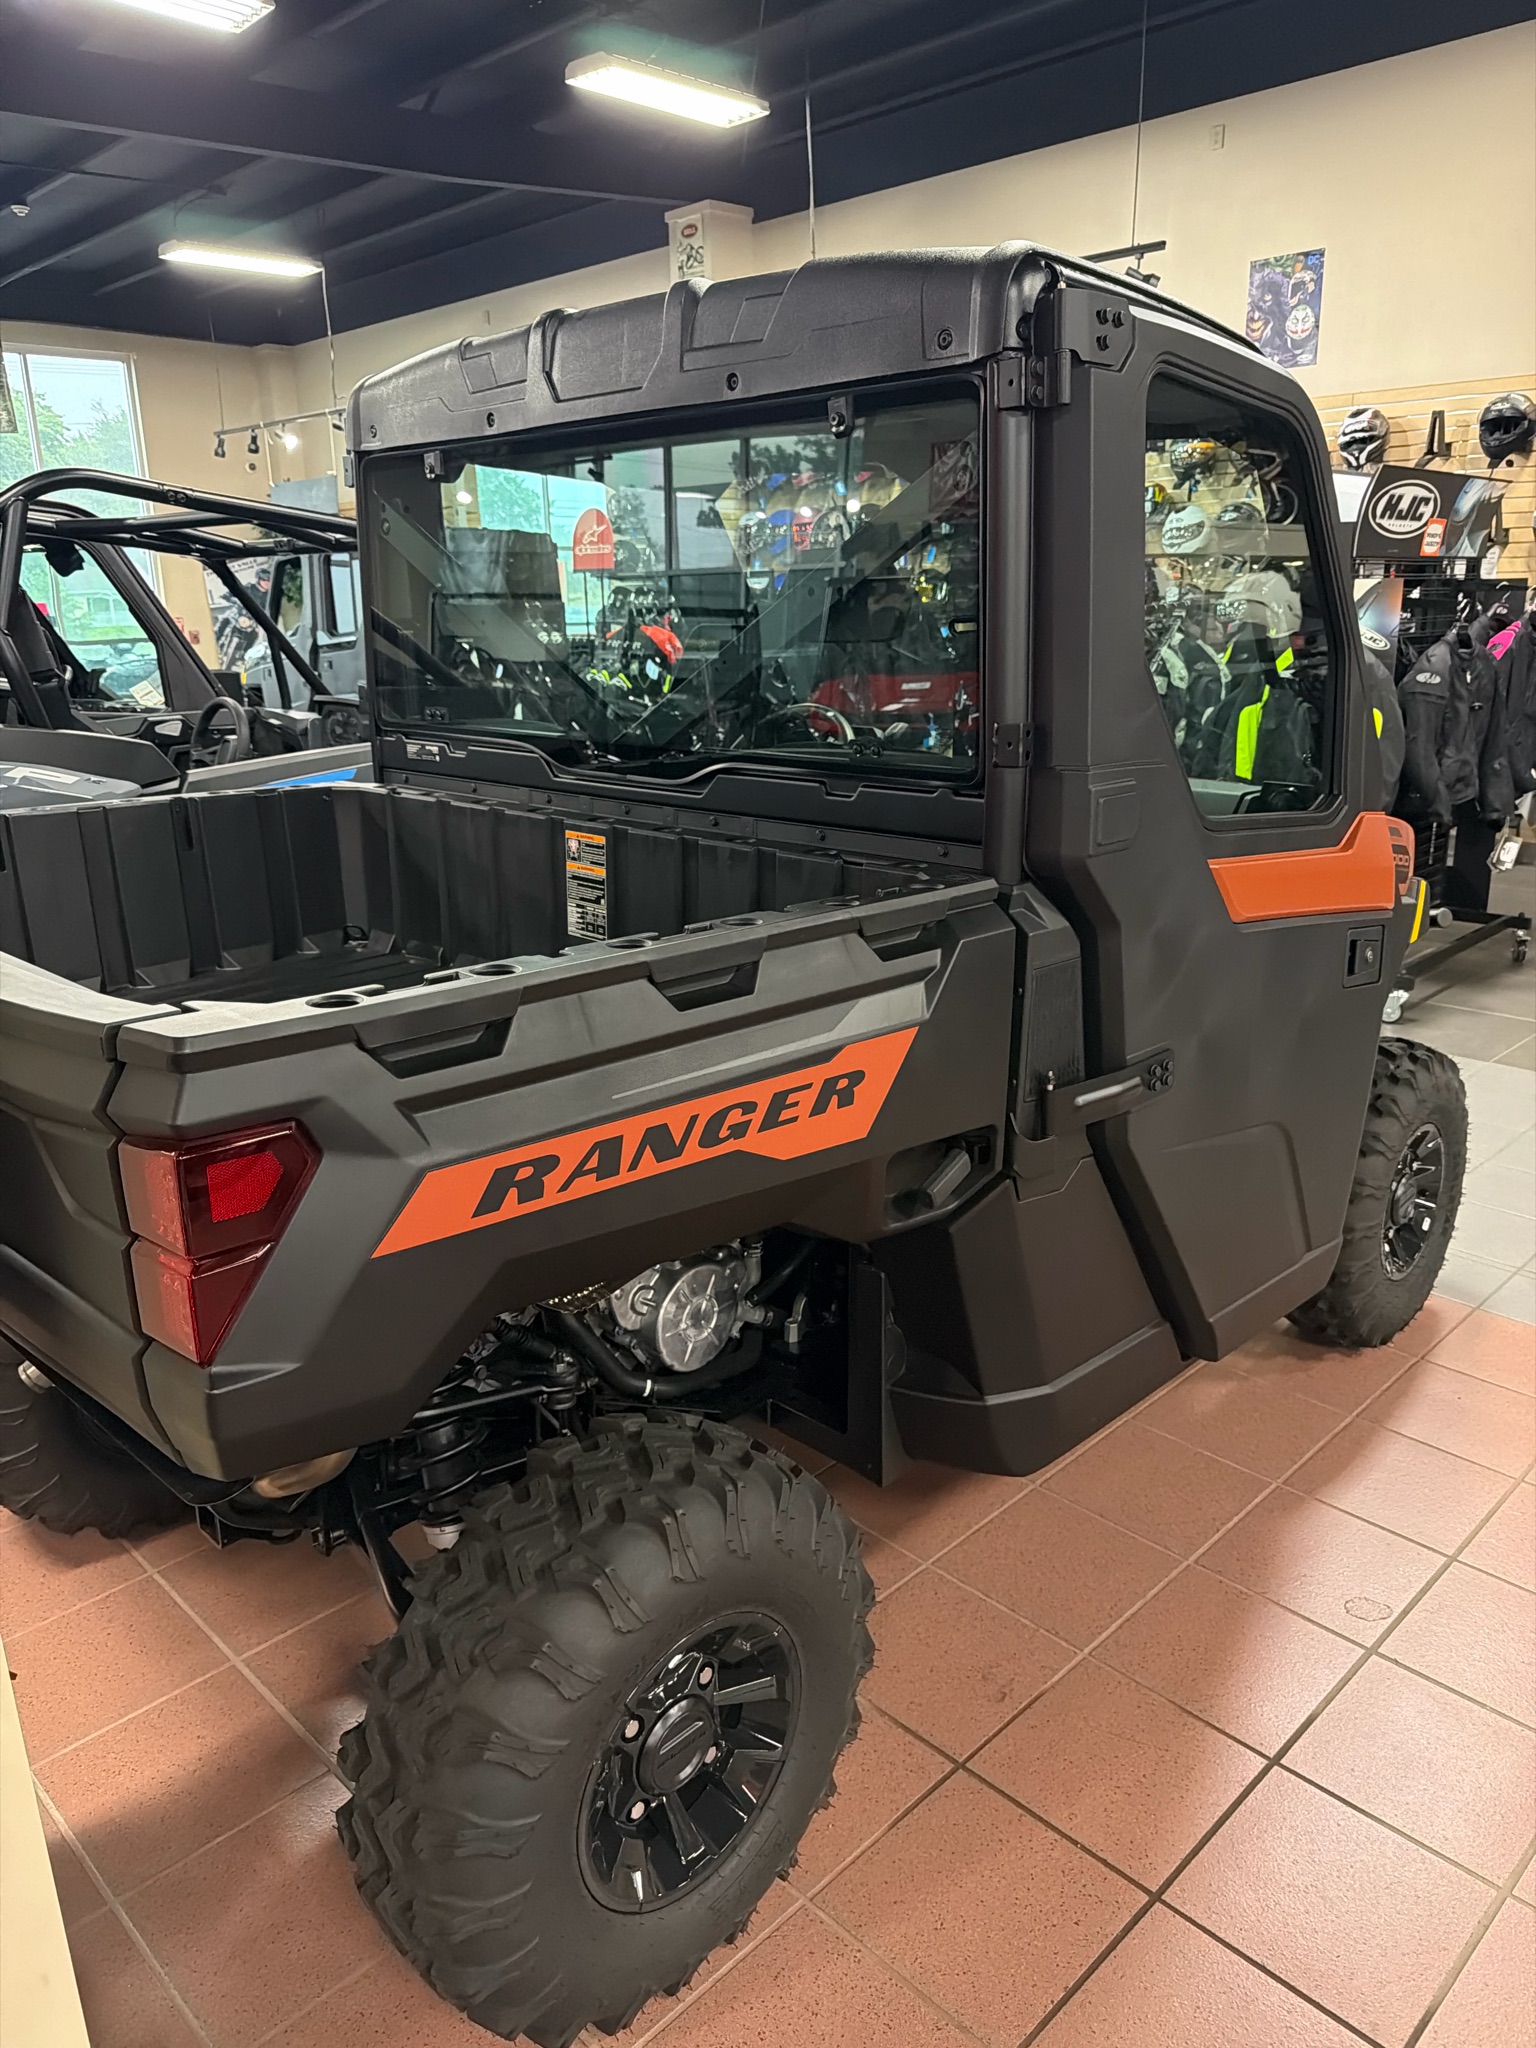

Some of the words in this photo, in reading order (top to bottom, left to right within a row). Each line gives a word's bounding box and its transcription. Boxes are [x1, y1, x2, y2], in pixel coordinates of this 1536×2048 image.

[1307, 255, 1320, 265] DC
[1378, 493, 1432, 522] HJC
[471, 1069, 866, 1219] RANGER
